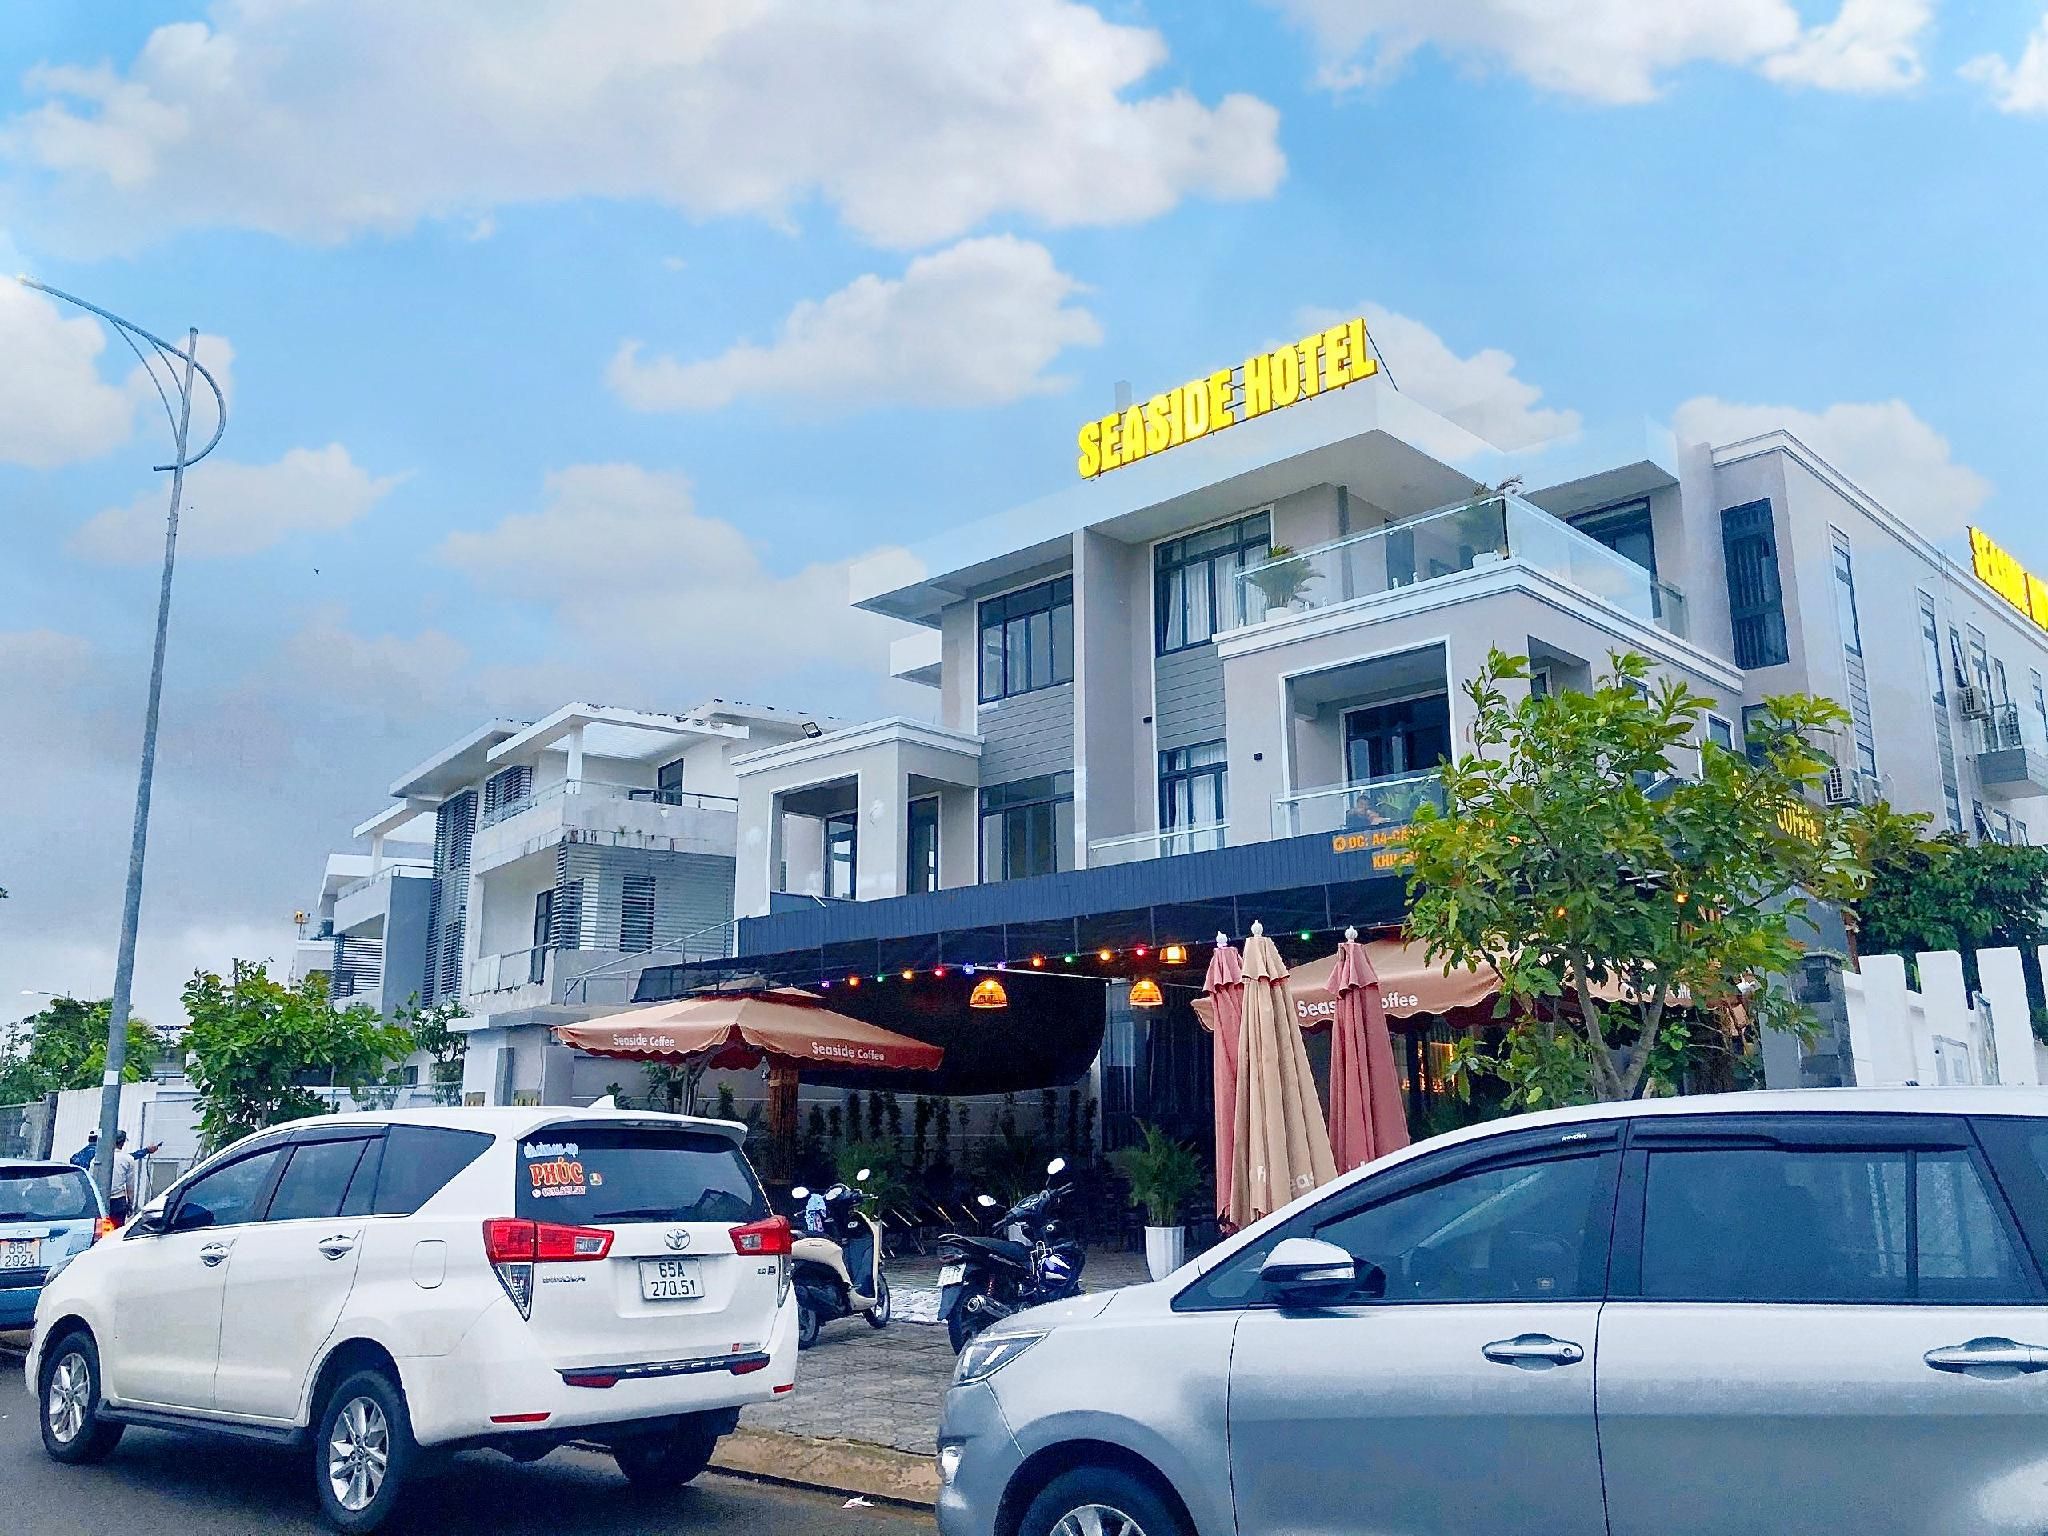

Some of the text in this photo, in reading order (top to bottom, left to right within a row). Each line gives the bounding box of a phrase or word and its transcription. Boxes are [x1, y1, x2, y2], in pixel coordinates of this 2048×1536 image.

[1078, 318, 1378, 479] SEASIDE HOTEL
[1297, 992, 1419, 1018] Seas offee
[613, 1034, 675, 1047] Seaside Coffee
[811, 1041, 885, 1061] Seaside Coffee
[658, 1262, 685, 1278] 65A
[651, 1280, 696, 1297] 270.51
